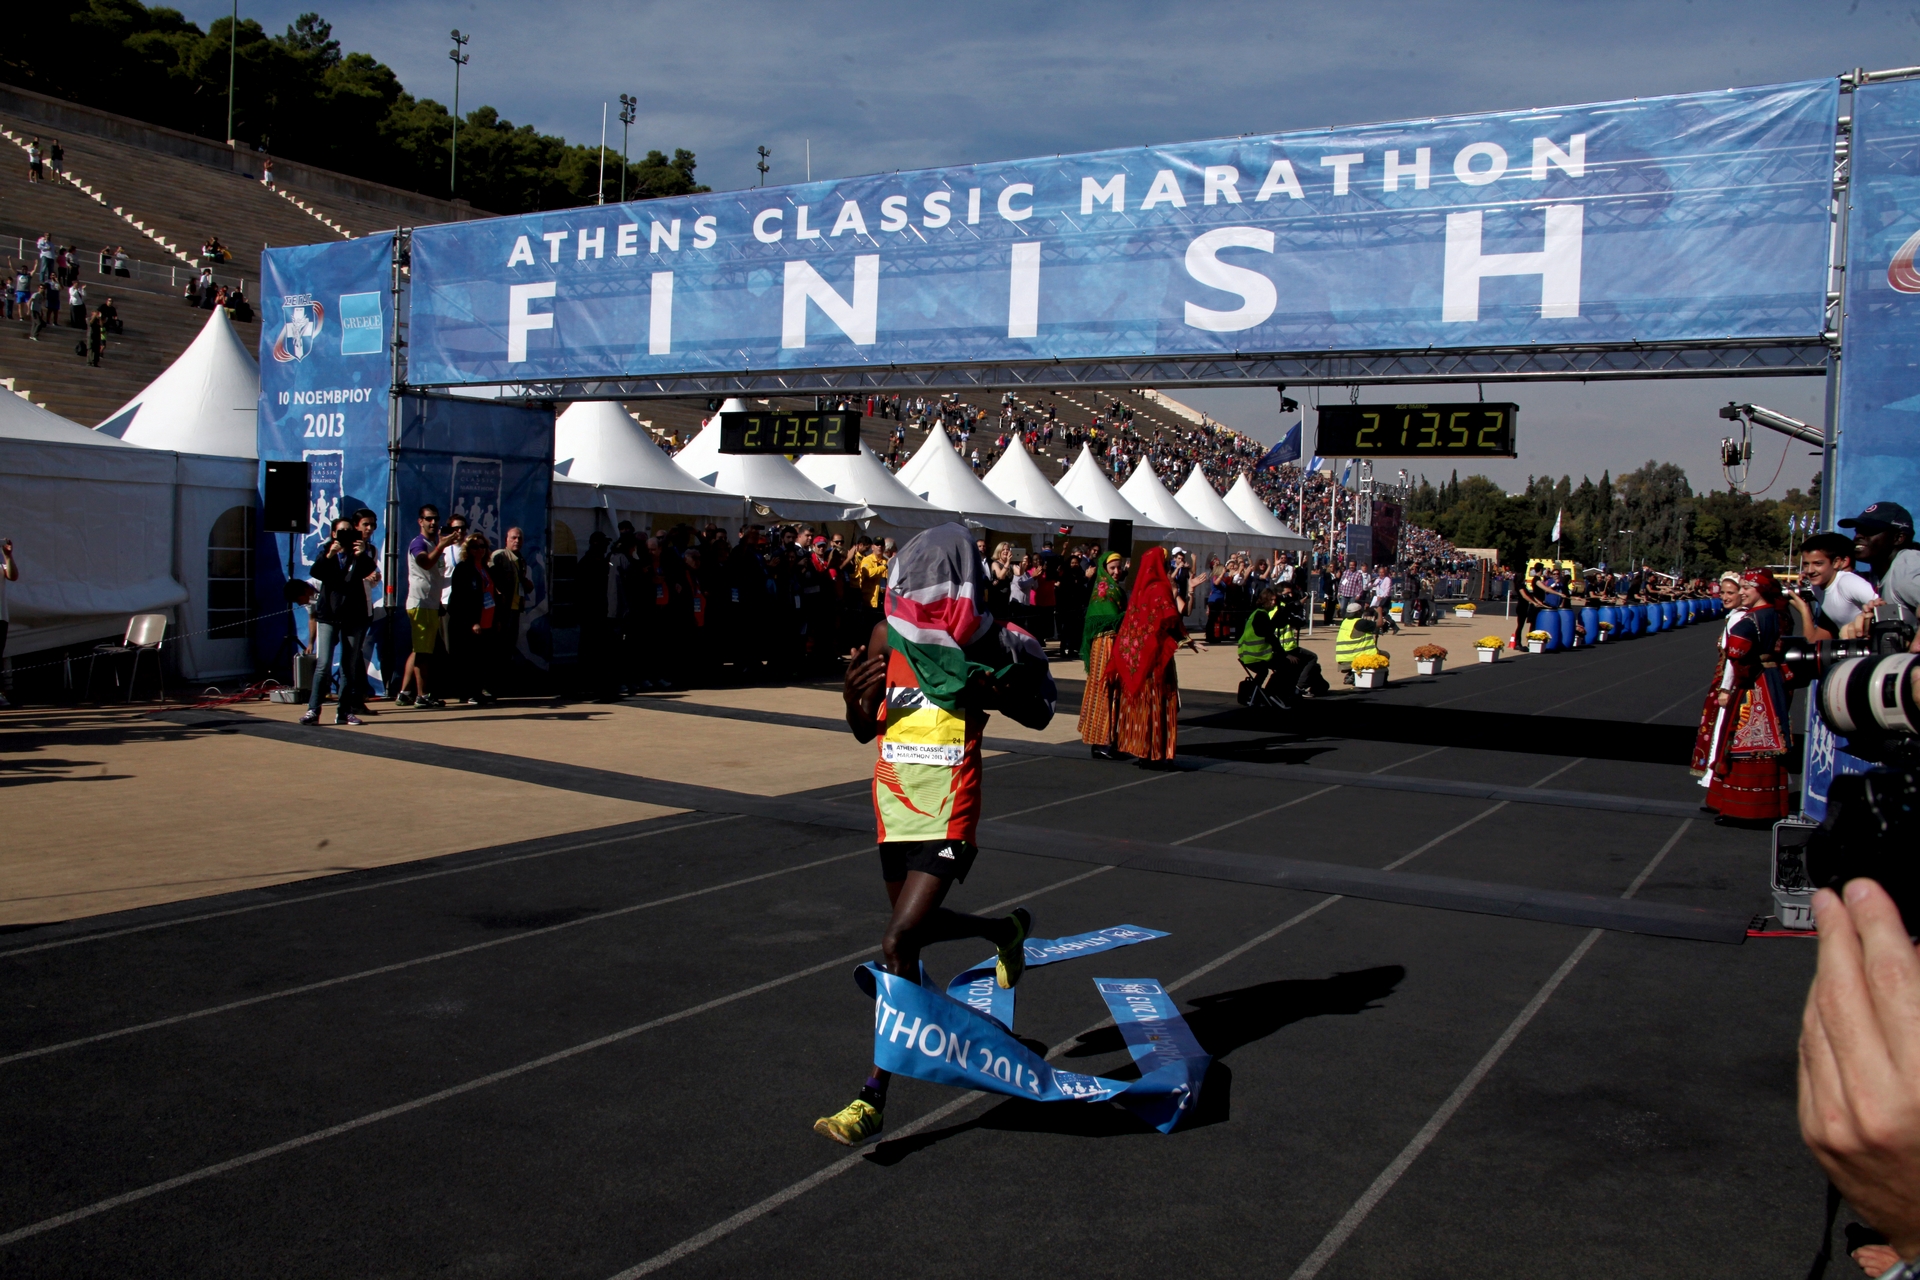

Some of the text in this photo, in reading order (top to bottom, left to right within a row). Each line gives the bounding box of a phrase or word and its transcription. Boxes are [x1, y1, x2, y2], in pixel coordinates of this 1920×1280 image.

[507, 133, 1587, 268] ATHENS CLASSIC MARATHON
[507, 204, 1585, 363] FINISH
[343, 315, 381, 329] GREECE
[293, 388, 372, 405] ΝΟΕΜΒΡΙΟΥ
[303, 412, 345, 438] 2013
[896, 744, 918, 752] ATHENS
[1125, 996, 1158, 1013] 2013
[979, 1047, 1041, 1095] 2013
